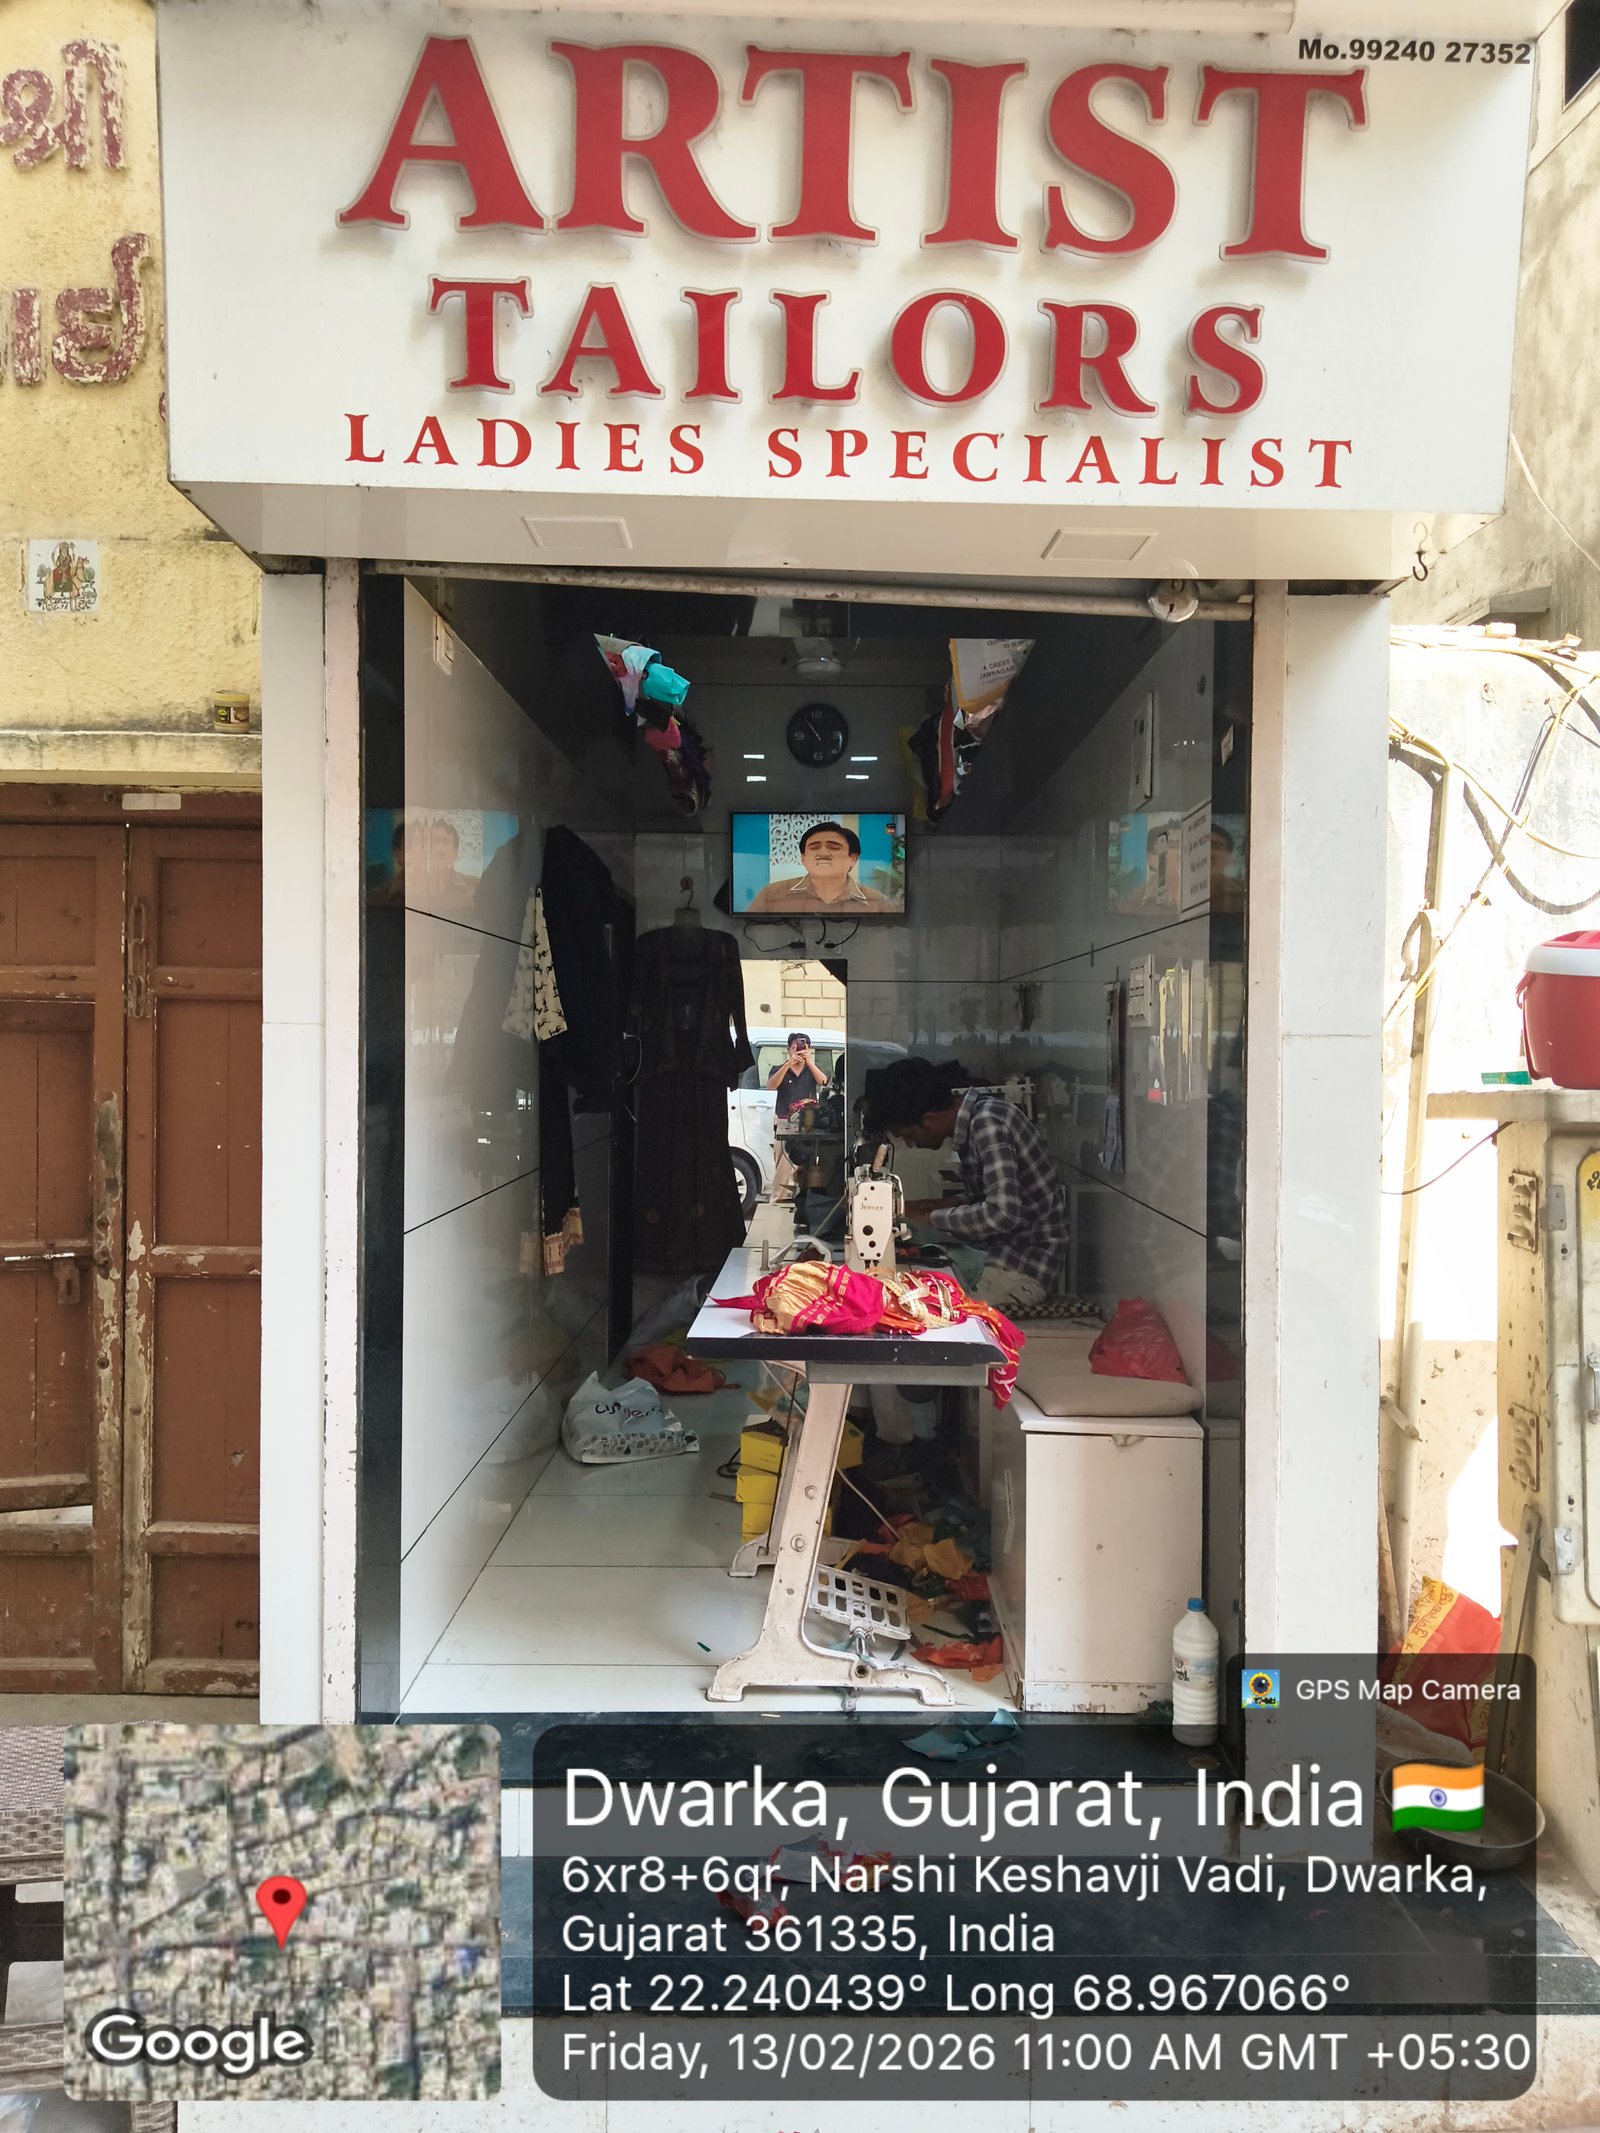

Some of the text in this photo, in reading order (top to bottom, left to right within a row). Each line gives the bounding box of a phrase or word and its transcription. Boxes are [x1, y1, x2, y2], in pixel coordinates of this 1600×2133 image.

[1297, 38, 1532, 65] Mo.99240 27352
[338, 36, 1367, 260] ARTIST
[429, 276, 1265, 416] TAILORS
[345, 412, 1353, 489] LADIES SPECIALIST
